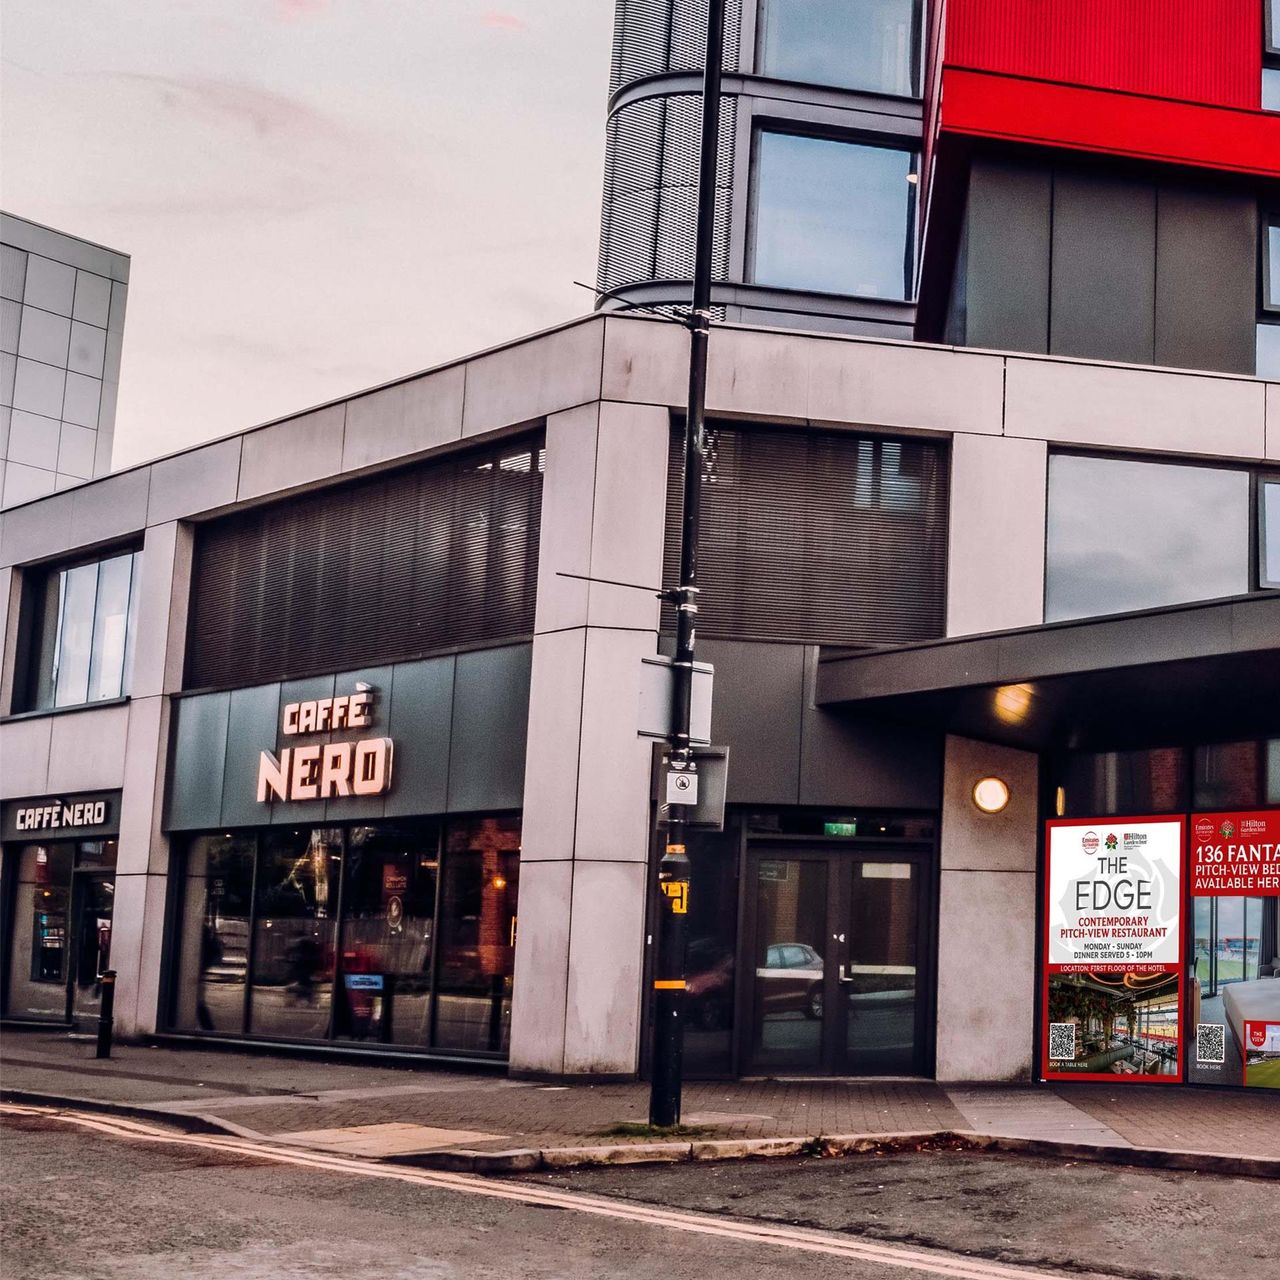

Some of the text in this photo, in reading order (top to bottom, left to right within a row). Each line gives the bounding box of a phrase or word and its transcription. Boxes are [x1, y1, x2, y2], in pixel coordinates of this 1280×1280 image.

[283, 681, 375, 735] CAFFÈ
[257, 737, 394, 803] NERO
[62, 801, 105, 827] NERO
[1196, 845, 1223, 863] 136
[1097, 856, 1127, 874] THE
[1195, 863, 1260, 876] PITCH-VIEW
[1195, 877, 1254, 889] AVAILABLE
[1076, 879, 1151, 911] EDGE
[1078, 916, 1149, 927] CONTEMPORARY
[1060, 927, 1167, 938] PITCH-VIEW RESTAURANT
[1116, 942, 1142, 950] SUNDAY
[1073, 951, 1098, 959] DINNER
[1100, 951, 1124, 959] SERVED
[1125, 951, 1130, 959] 5
[1136, 951, 1153, 959] 10PM
